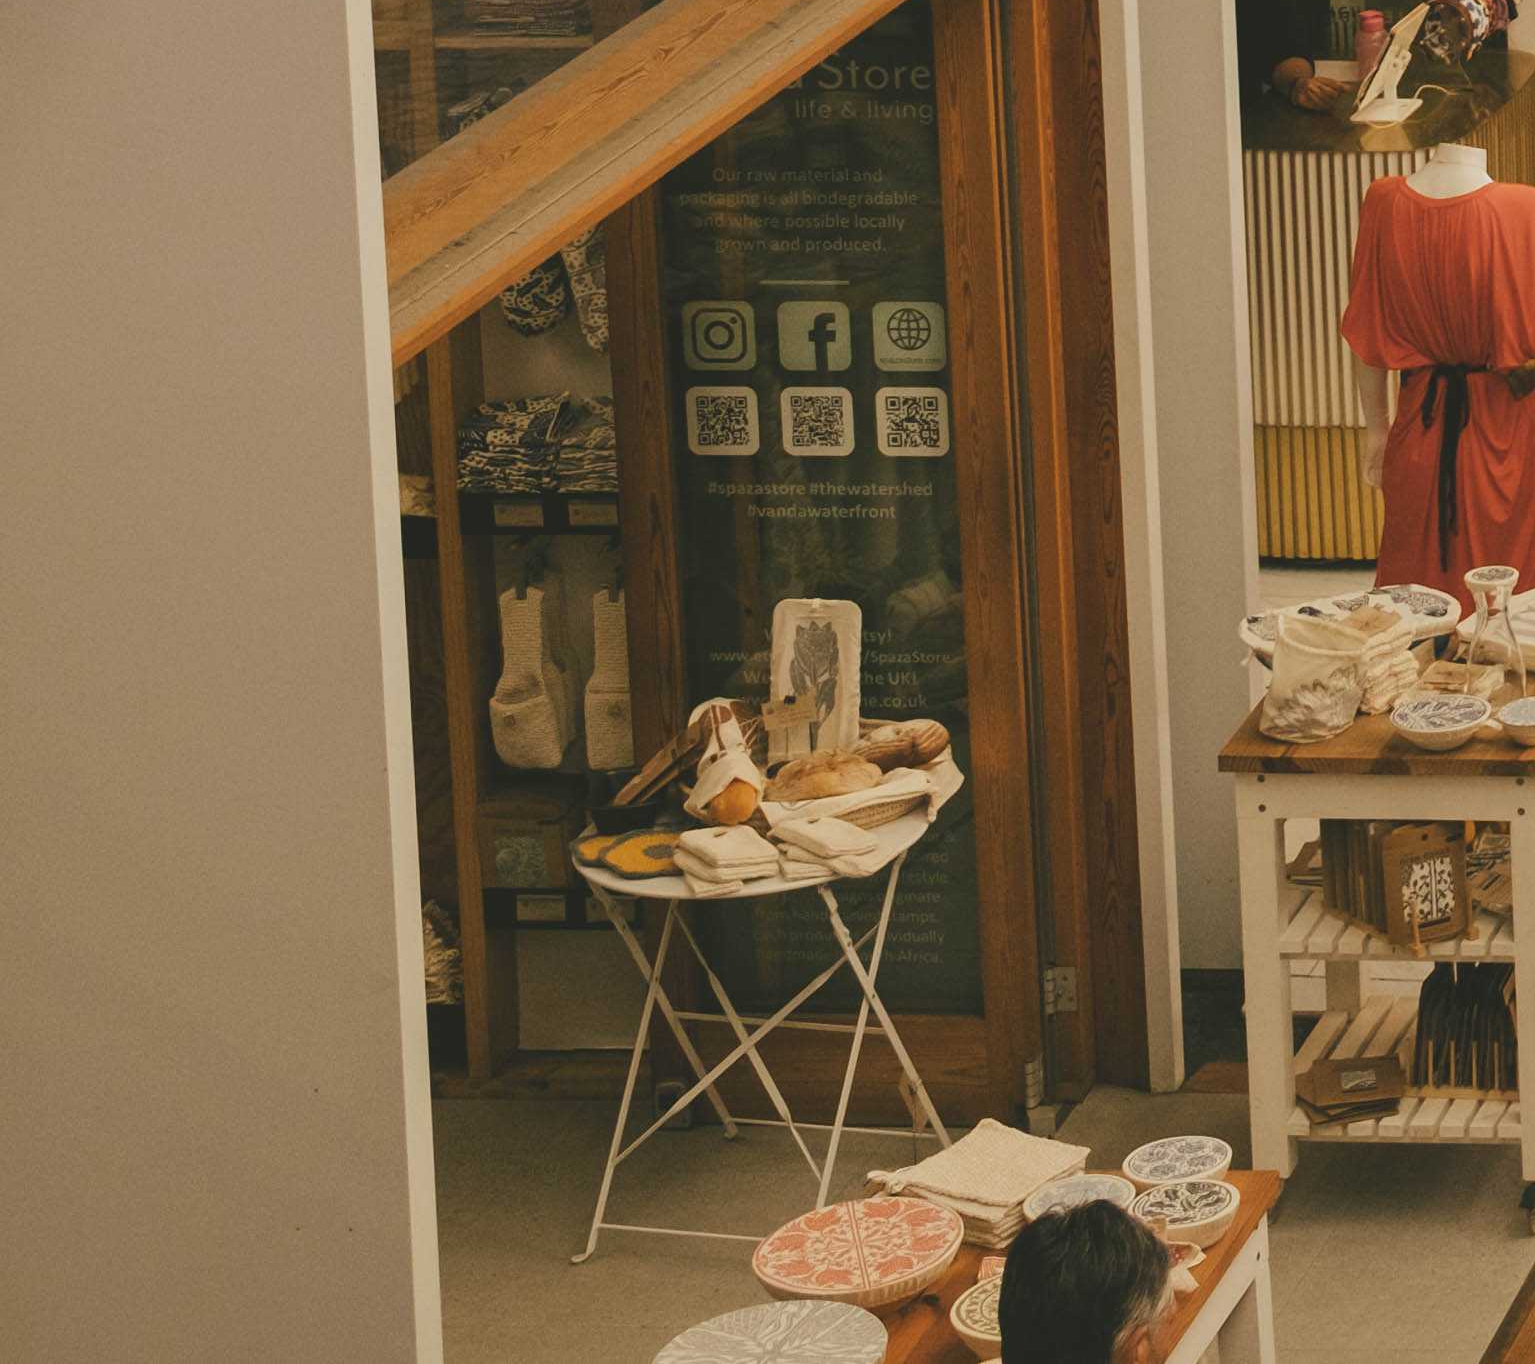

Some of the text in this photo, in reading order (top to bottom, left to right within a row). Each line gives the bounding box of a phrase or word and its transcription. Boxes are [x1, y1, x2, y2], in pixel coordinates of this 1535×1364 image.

[817, 58, 932, 90] Store
[795, 99, 935, 125] life & living
[712, 167, 883, 183] Our raw material and
[679, 191, 760, 209] packaging
[763, 191, 776, 206] is
[802, 190, 918, 209] biodegradable
[784, 214, 851, 231] possible
[854, 213, 905, 231] locally
[770, 237, 800, 251] and
[707, 481, 933, 497] #spazastore #thewatershed
[746, 504, 897, 520] #vandawaterfront
